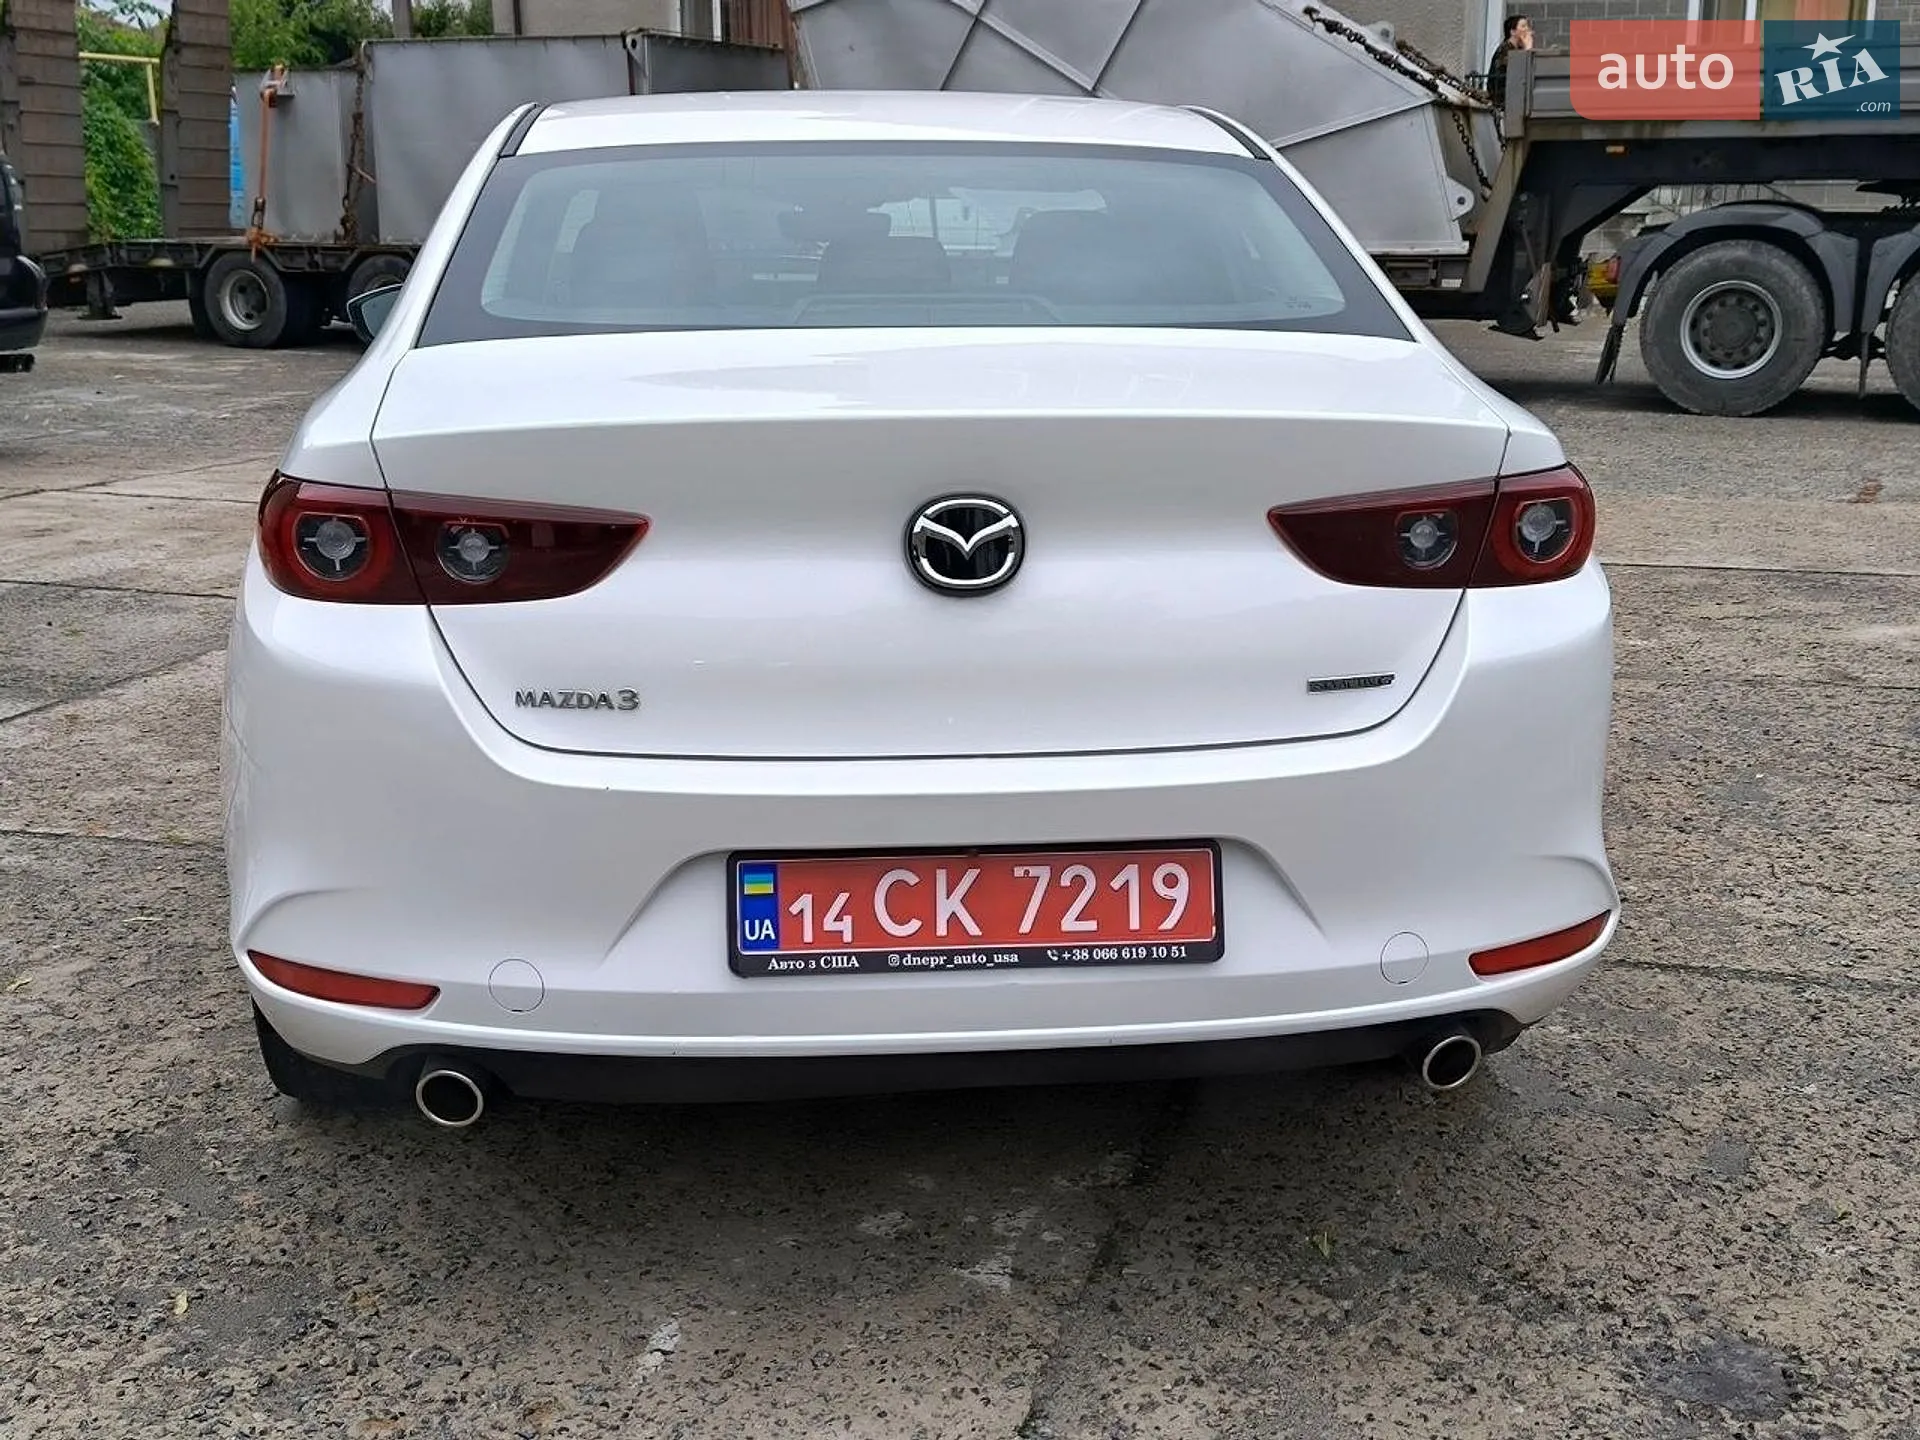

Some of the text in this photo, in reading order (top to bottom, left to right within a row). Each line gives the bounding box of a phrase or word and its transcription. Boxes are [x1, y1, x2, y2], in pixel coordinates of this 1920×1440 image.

[788, 862, 1190, 944] 14 CK 7219
[744, 919, 776, 941] UA
[767, 955, 860, 970] Авто з США
[1062, 945, 1187, 961] +38 066 619 10 51
